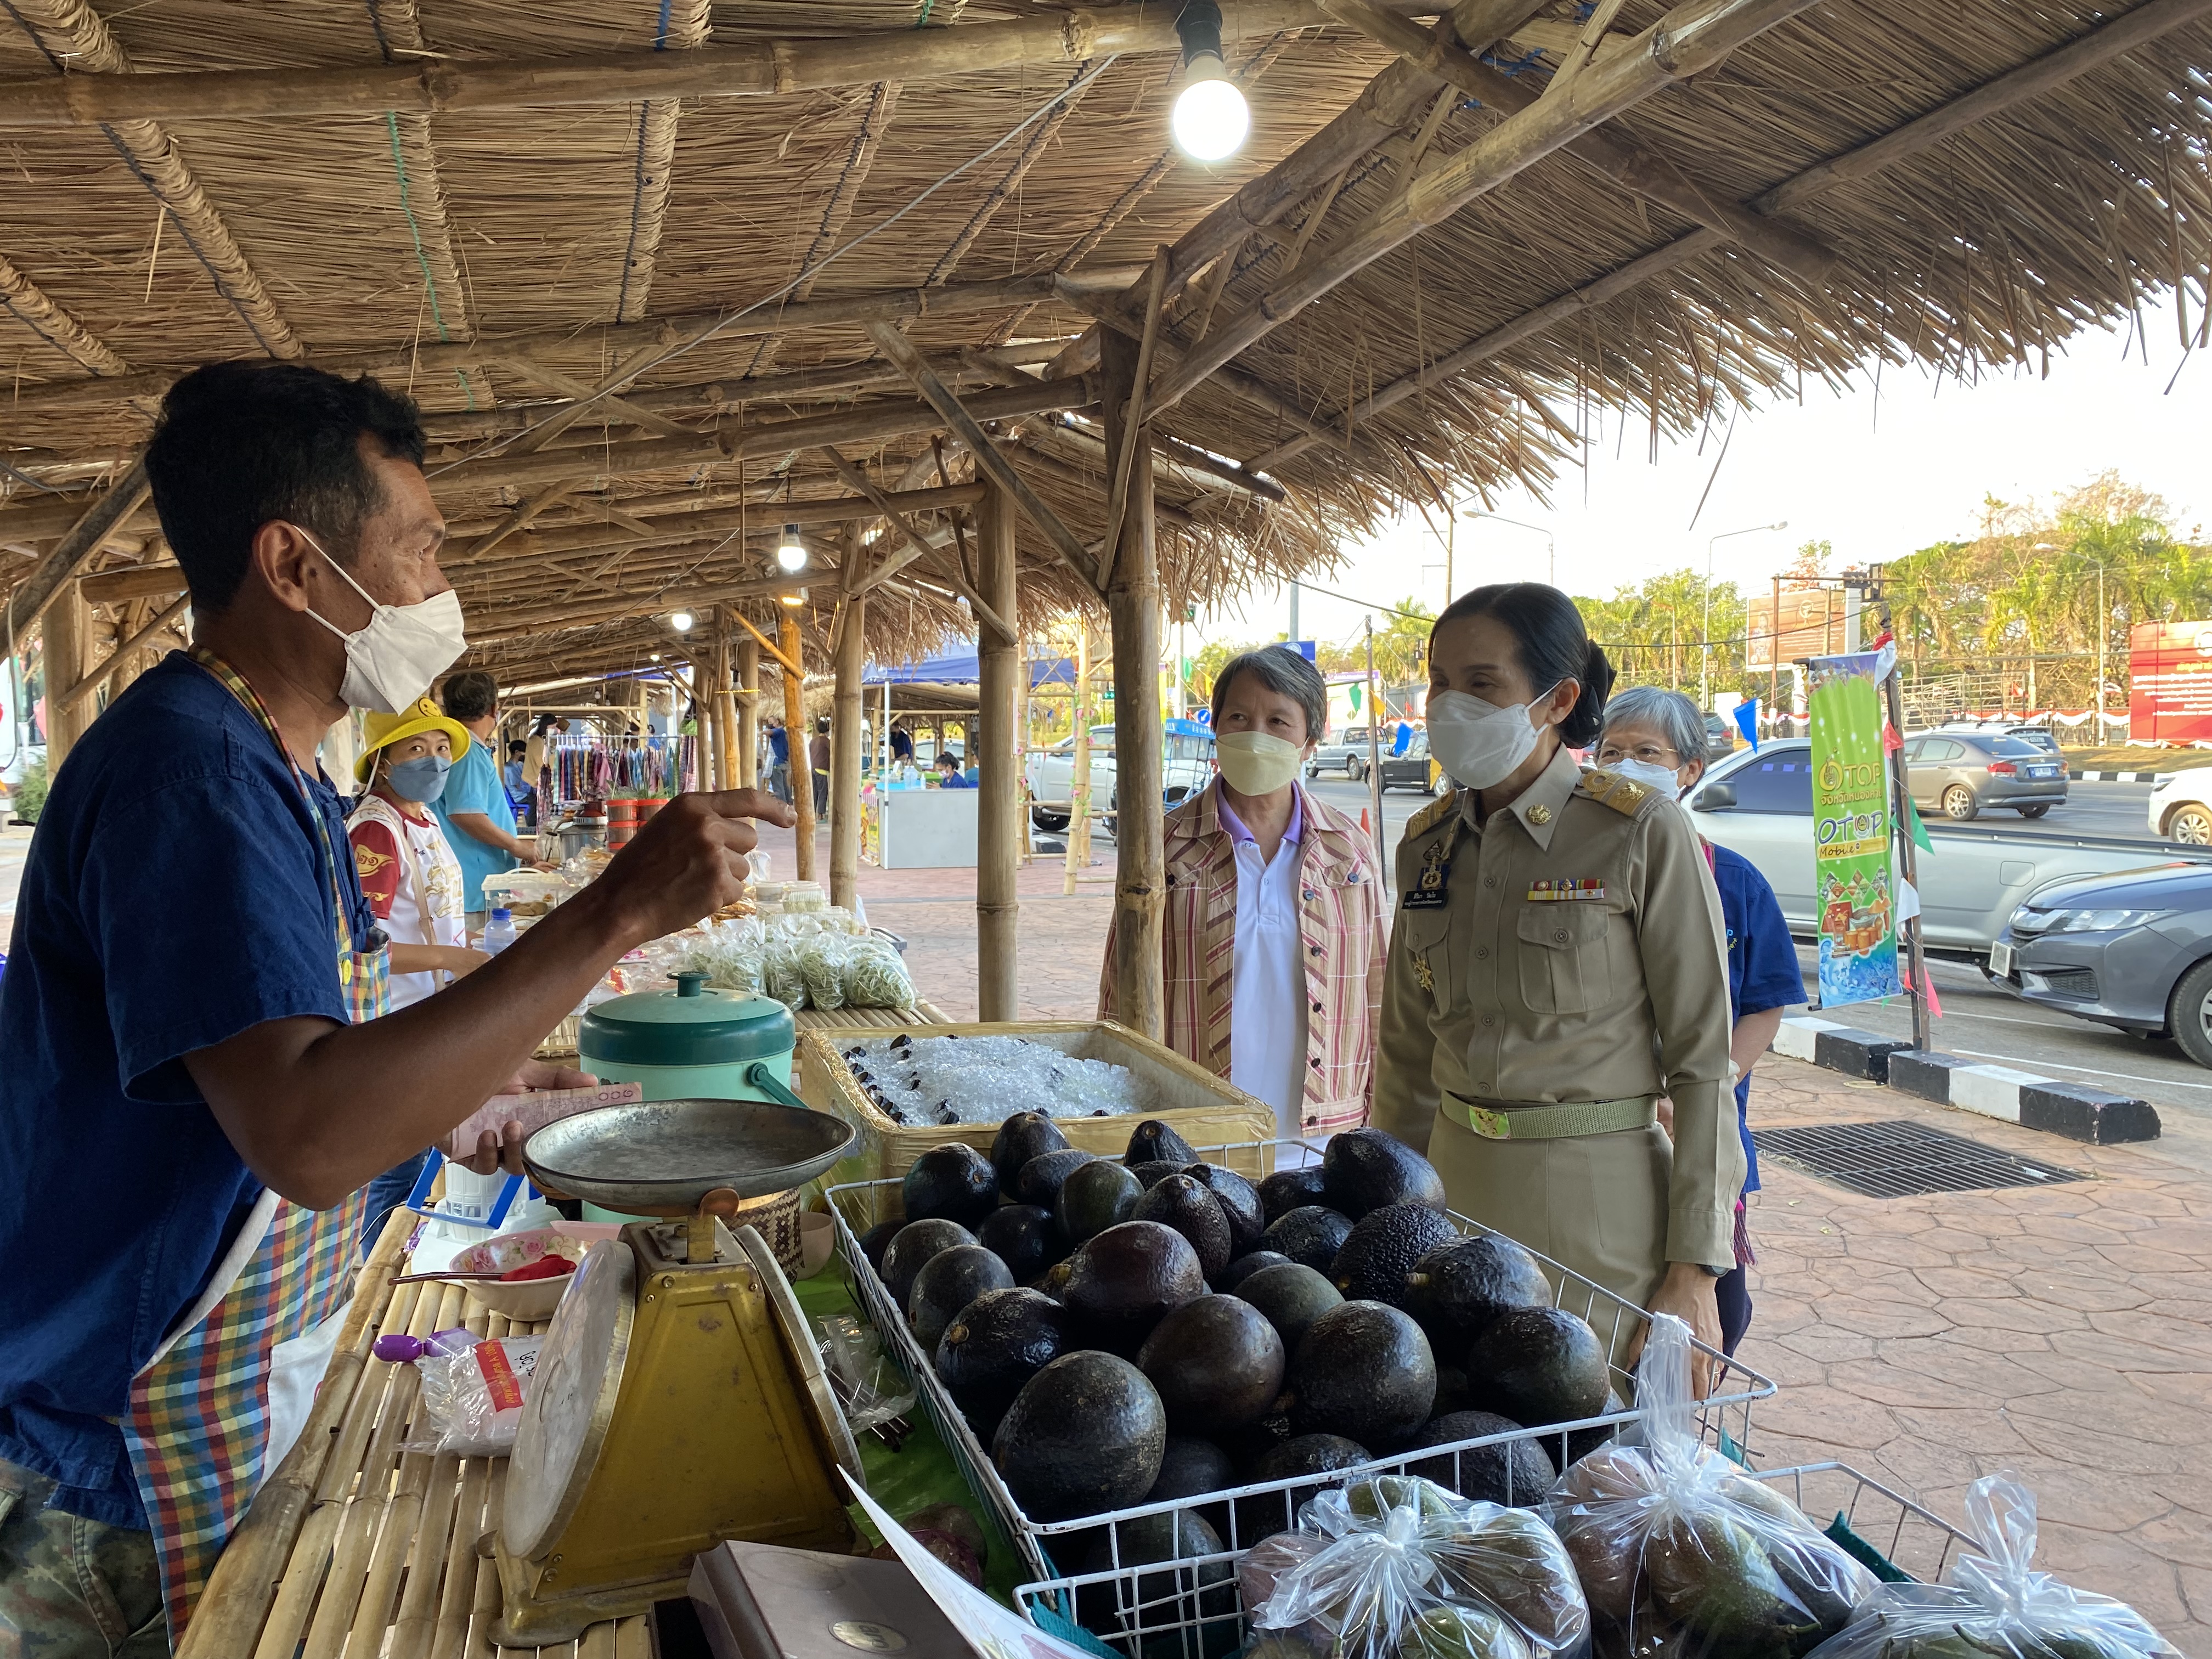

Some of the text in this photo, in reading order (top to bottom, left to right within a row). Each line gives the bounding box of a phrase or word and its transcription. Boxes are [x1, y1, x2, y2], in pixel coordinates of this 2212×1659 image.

[1819, 760, 1882, 791] OTOP
[1820, 788, 1882, 806] จังหวัดหนองคาย
[1818, 810, 1883, 844] OTOP
[1819, 844, 1855, 858] Mobile
